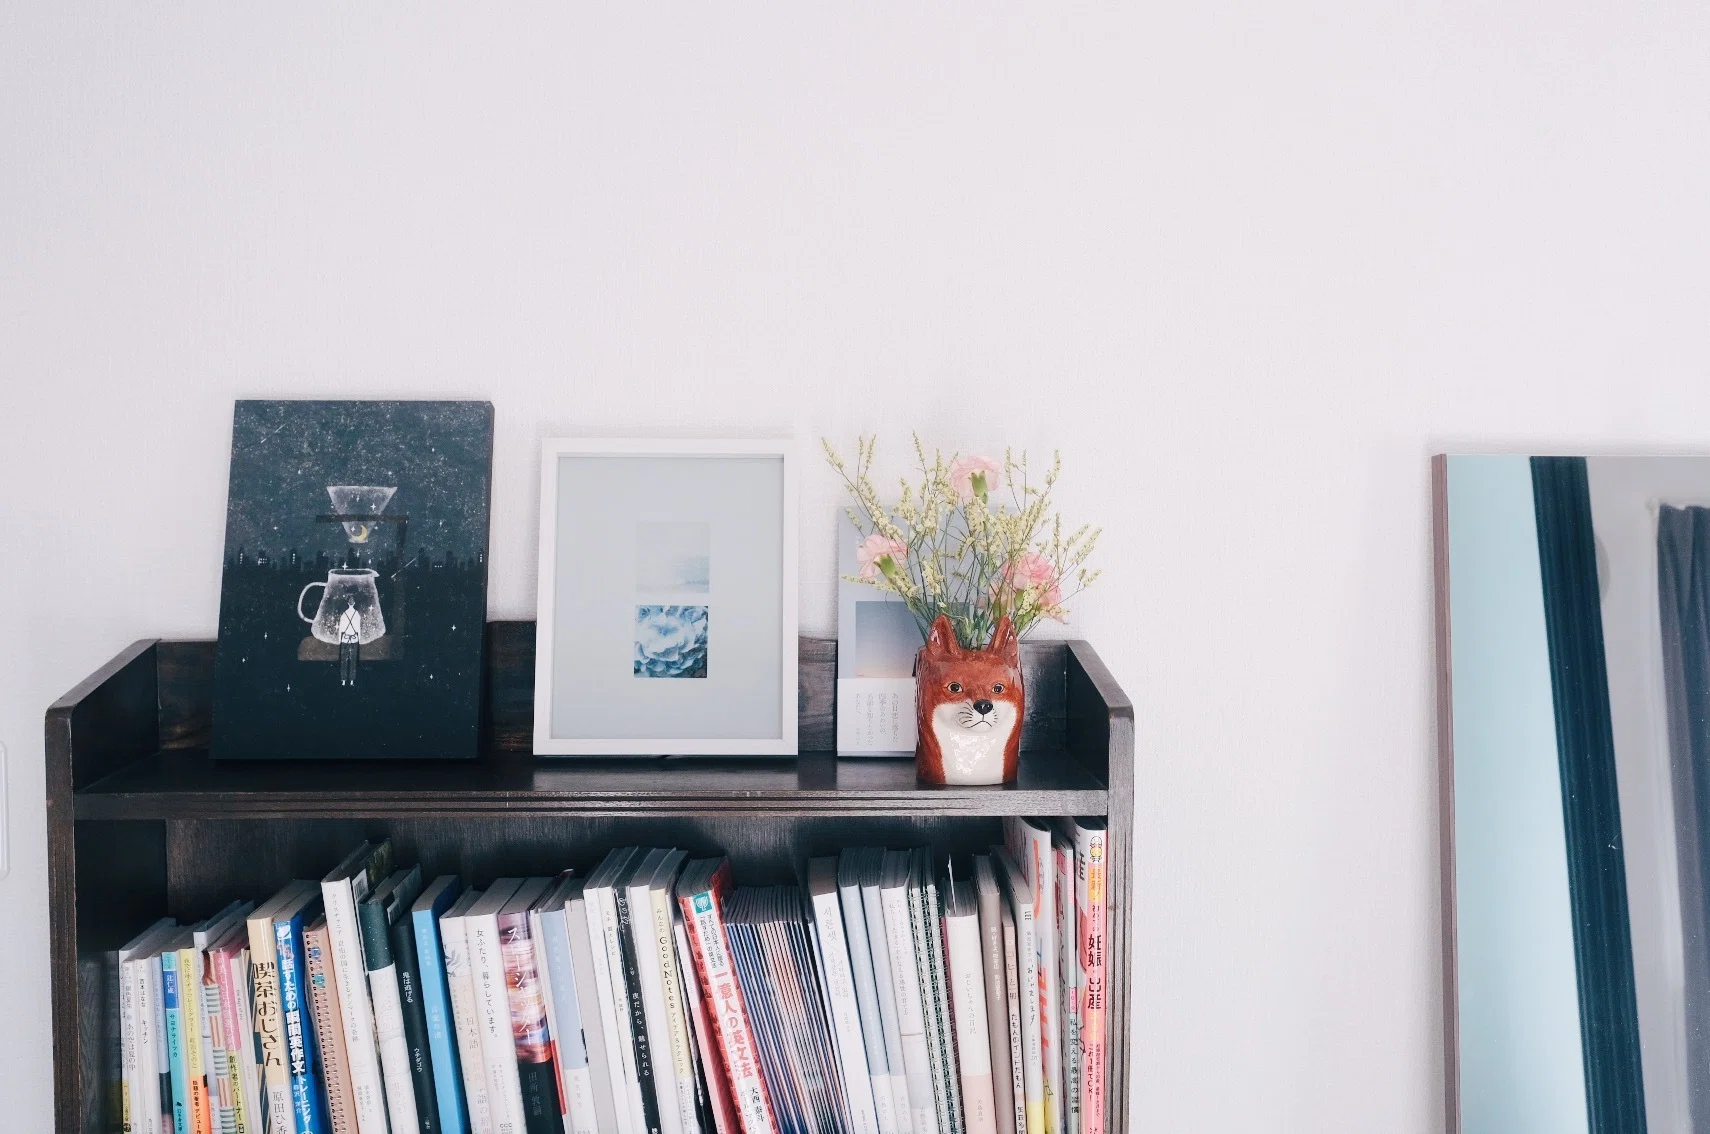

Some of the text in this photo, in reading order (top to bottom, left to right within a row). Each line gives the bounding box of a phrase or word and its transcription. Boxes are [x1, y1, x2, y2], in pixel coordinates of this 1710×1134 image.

[142, 1019, 150, 1046] キッチン
[169, 1014, 180, 1058] サヨナライツカ
[252, 961, 281, 1068] 喫茶おじさん
[475, 928, 499, 1039] 女ふたり、暮らしています。
[507, 927, 533, 1046] スローシャッター
[632, 991, 651, 1077] 夜だから、魅せられる
[713, 971, 754, 1080] 一億人の英文法
